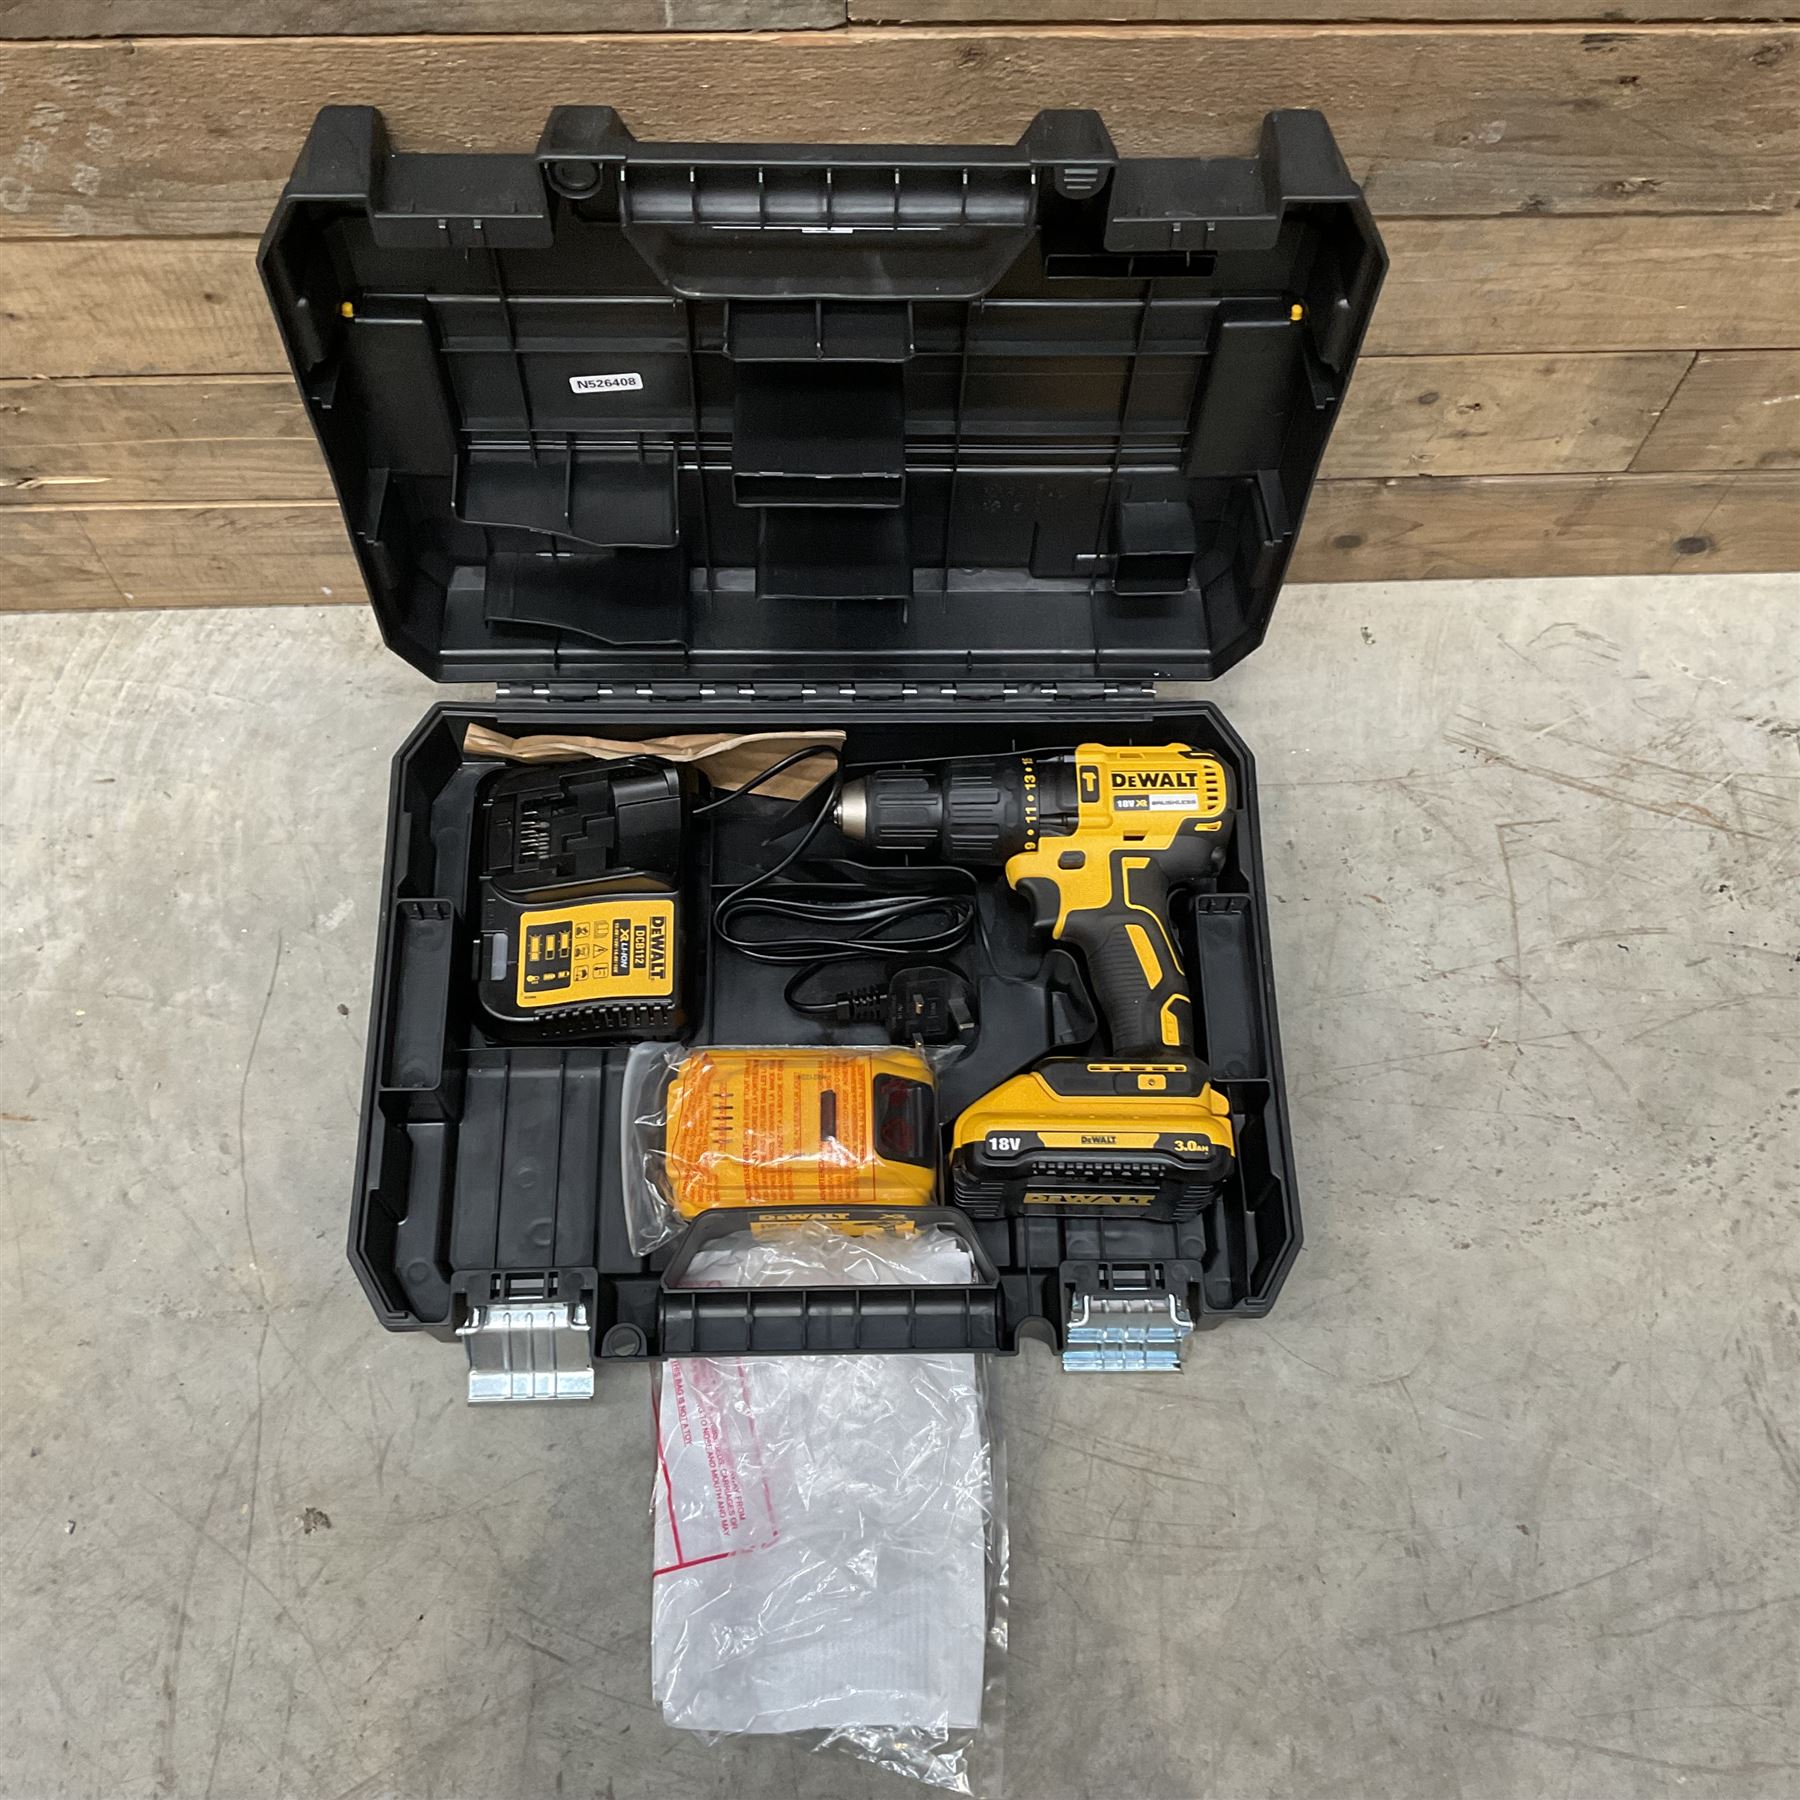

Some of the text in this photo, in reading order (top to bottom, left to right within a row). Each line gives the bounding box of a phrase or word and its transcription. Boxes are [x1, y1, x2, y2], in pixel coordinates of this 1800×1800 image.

[576, 377, 637, 389] N526408
[1023, 775, 1036, 790] 13
[1111, 772, 1198, 788] DEWALT
[1116, 799, 1135, 808] 18V
[1135, 799, 1148, 808] XR
[1024, 807, 1037, 824] 11
[1024, 842, 1036, 850] 9
[620, 928, 629, 968] XR LI-ION
[635, 930, 646, 965] DCB112
[651, 916, 665, 980] DEWALT
[988, 1137, 1021, 1151] 18V
[1081, 1136, 1117, 1145] DEWALT
[674, 1379, 684, 1395] BAG
[679, 1406, 689, 1422] NOT
[684, 1430, 693, 1446] TOY
[711, 1470, 722, 1499] MOUTH
[720, 1468, 736, 1516] CARRIAGES
[717, 1501, 726, 1518] AND
[736, 1496, 746, 1520] FROM
[721, 1520, 730, 1537] MAY
